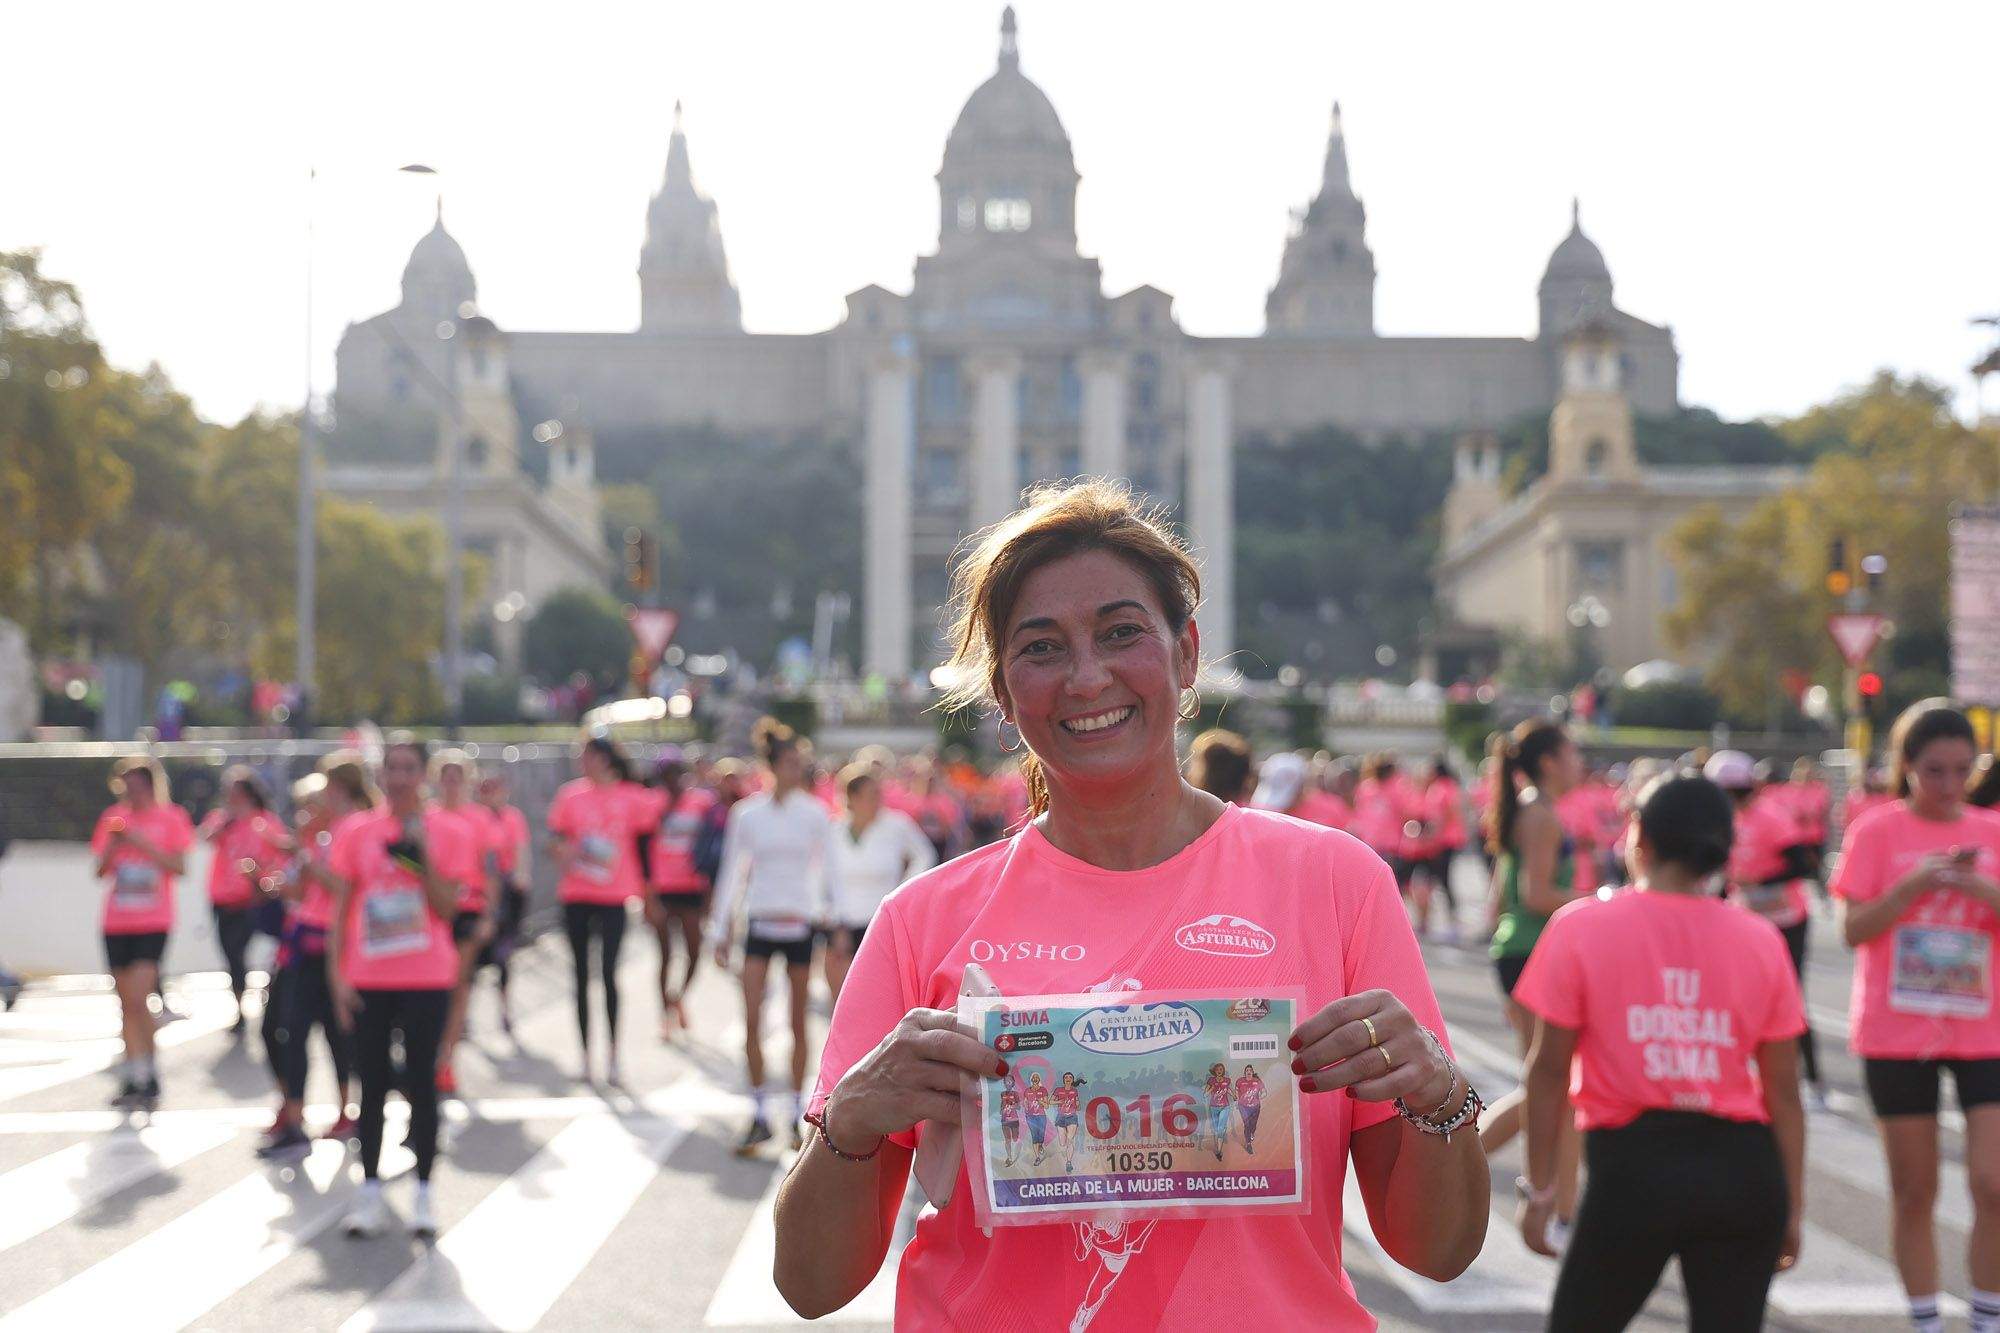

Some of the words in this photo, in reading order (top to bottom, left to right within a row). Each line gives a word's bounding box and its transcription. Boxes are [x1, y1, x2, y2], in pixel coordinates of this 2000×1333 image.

[970, 939, 1086, 963] OYSHO
[1182, 930, 1269, 951] ASTURIANA
[1661, 966, 1701, 1006] TU
[1000, 1010, 1050, 1028] SUMA
[1100, 1015, 1143, 1025] CENTRAL
[1147, 1010, 1190, 1021] LECHERA
[1080, 1018, 1194, 1043] ASTURIANA
[1085, 1093, 1199, 1140] 016
[1107, 1151, 1173, 1172] 10350
[1019, 1181, 1081, 1199] CARRERA
[1085, 1179, 1103, 1195] DE
[1106, 1179, 1124, 1194] LA
[1127, 1177, 1175, 1193] MUJER
[1186, 1175, 1269, 1191] BARCELONA
